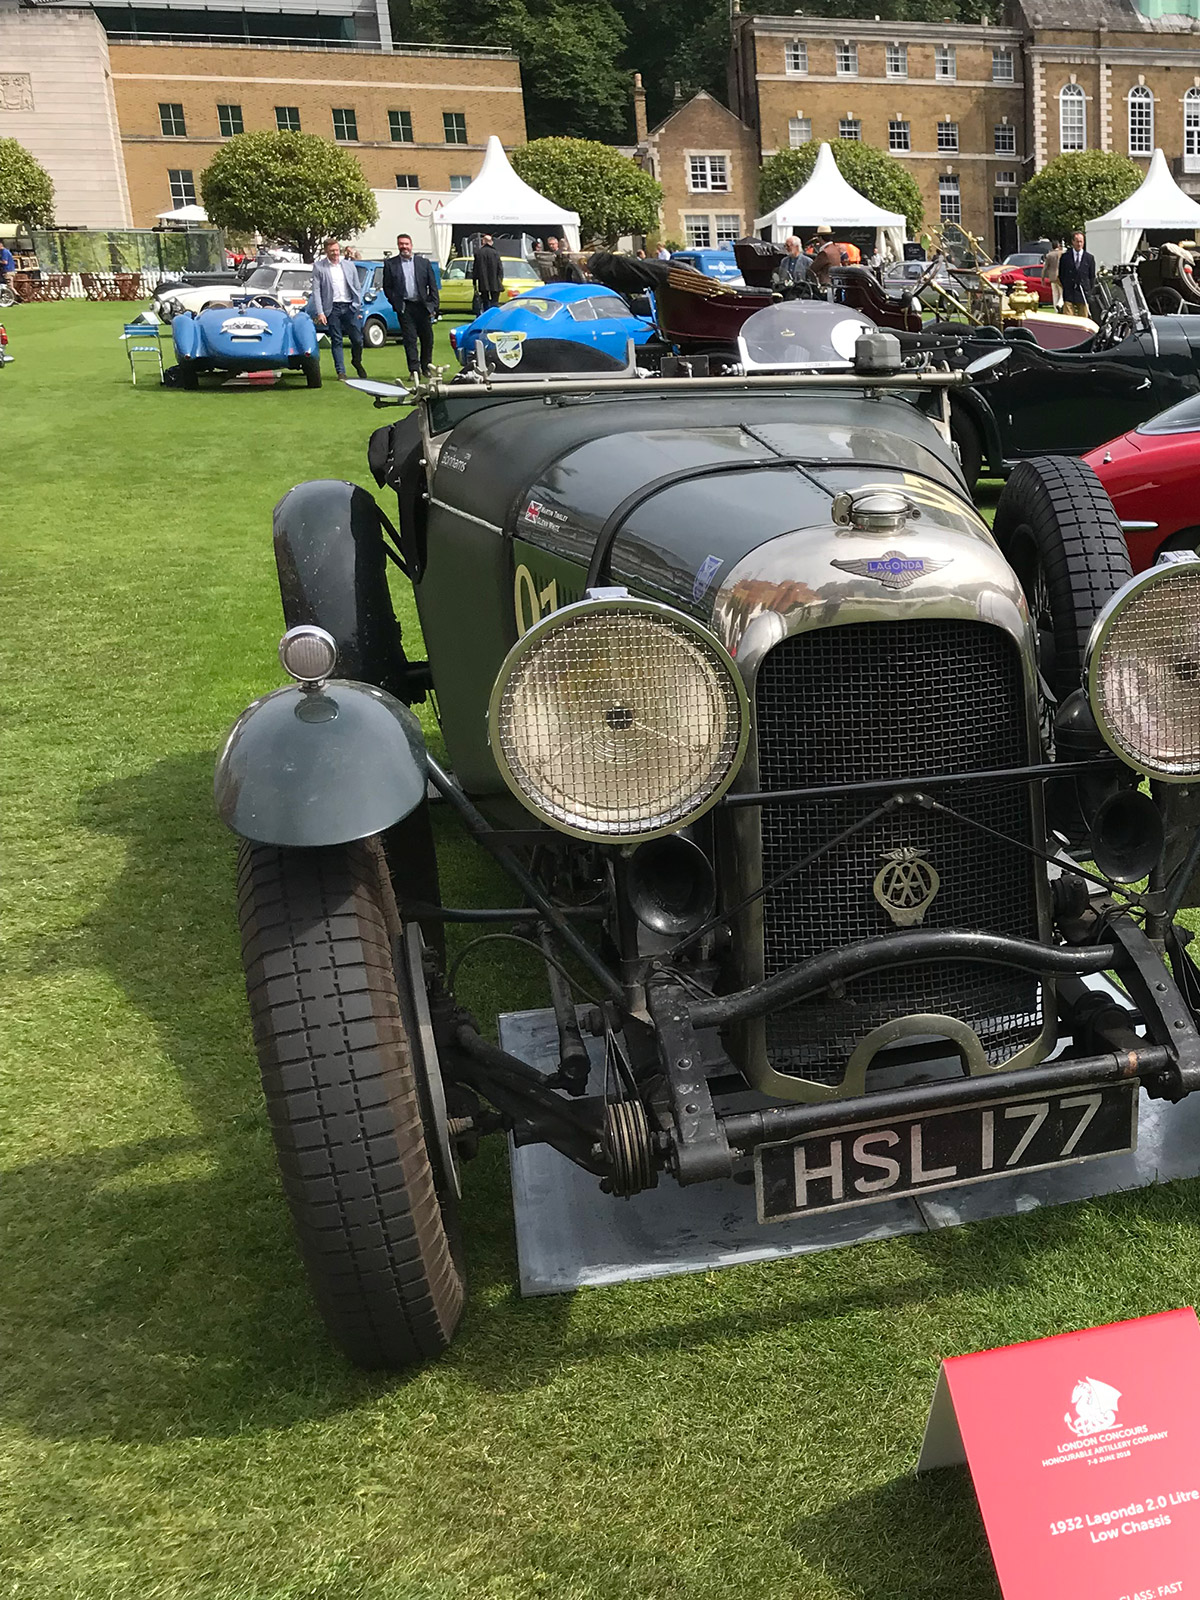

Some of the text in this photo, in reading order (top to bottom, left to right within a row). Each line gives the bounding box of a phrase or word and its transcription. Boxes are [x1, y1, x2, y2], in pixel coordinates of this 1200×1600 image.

[869, 560, 923, 571] LAGONDA
[793, 1093, 1103, 1208] HSL 177
[1042, 1431, 1168, 1467] HONOURABLE ARTILLERY COMPANY
[1057, 1424, 1149, 1453] LONDON CONCOURS
[1098, 1454, 1116, 1463] JUNE
[1116, 1450, 1132, 1459] 2018
[1049, 1489, 1200, 1535] 1932 Lagonda 2.0 Litre
[1089, 1514, 1172, 1543] Low Chassis
[1157, 1581, 1183, 1597] FAST
